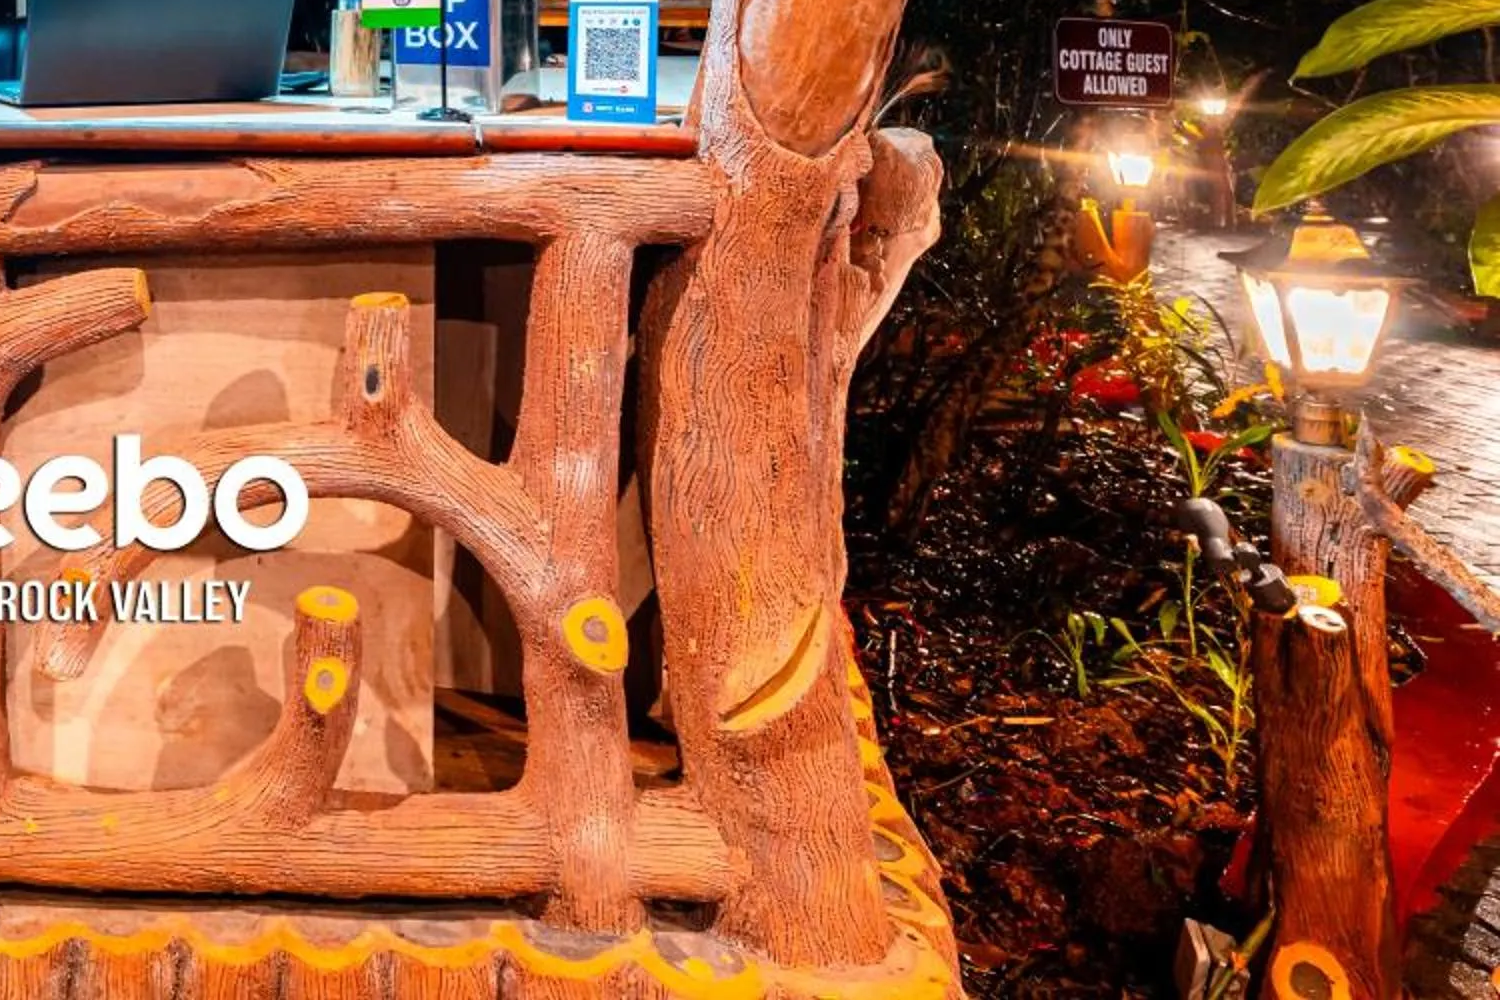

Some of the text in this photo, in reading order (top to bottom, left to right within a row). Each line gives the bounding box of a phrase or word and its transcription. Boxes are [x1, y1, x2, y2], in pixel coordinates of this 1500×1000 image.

[405, 21, 479, 50] BOX
[1098, 28, 1132, 48] ONLY
[1059, 49, 1168, 75] COTTAGE GUEST
[1083, 74, 1147, 96] ALLOWED
